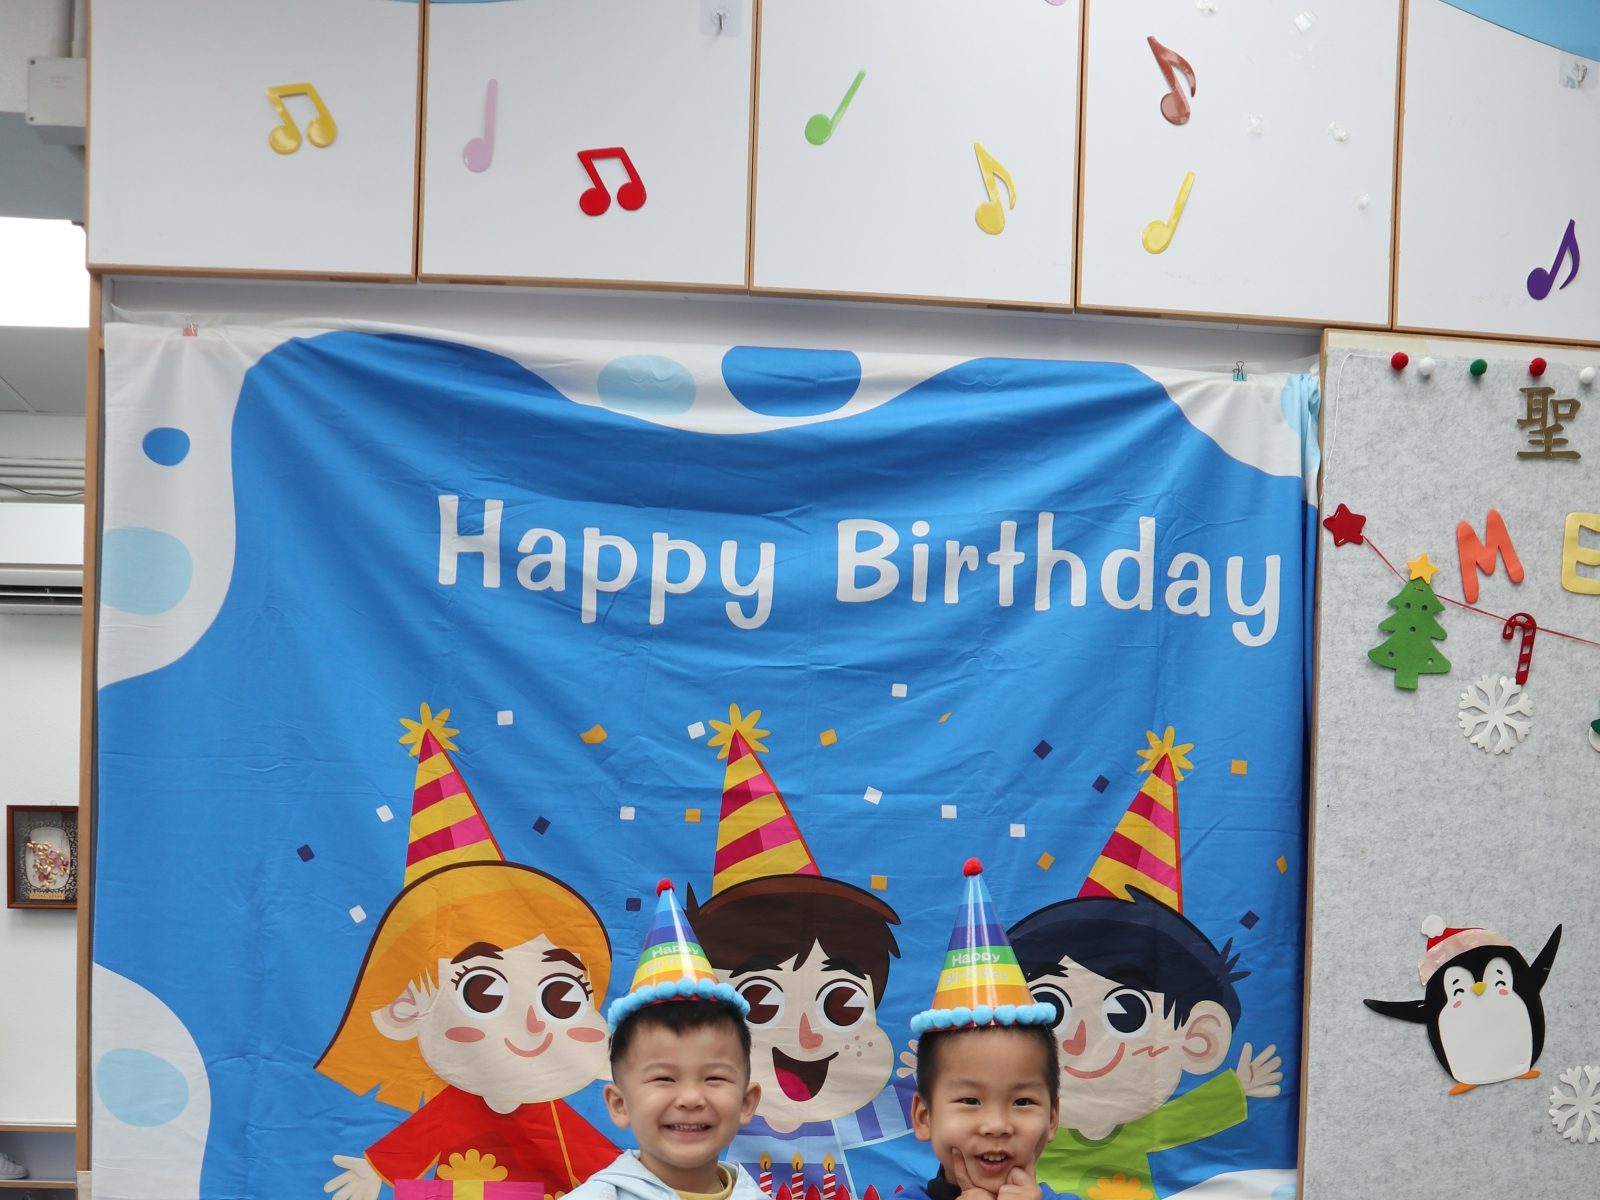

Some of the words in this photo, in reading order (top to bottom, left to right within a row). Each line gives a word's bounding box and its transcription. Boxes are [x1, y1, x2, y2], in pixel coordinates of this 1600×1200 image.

[1516, 386, 1582, 462] 聖
[434, 494, 777, 631] Happy
[836, 511, 1282, 647] Birthday
[952, 952, 1000, 967] Happy
